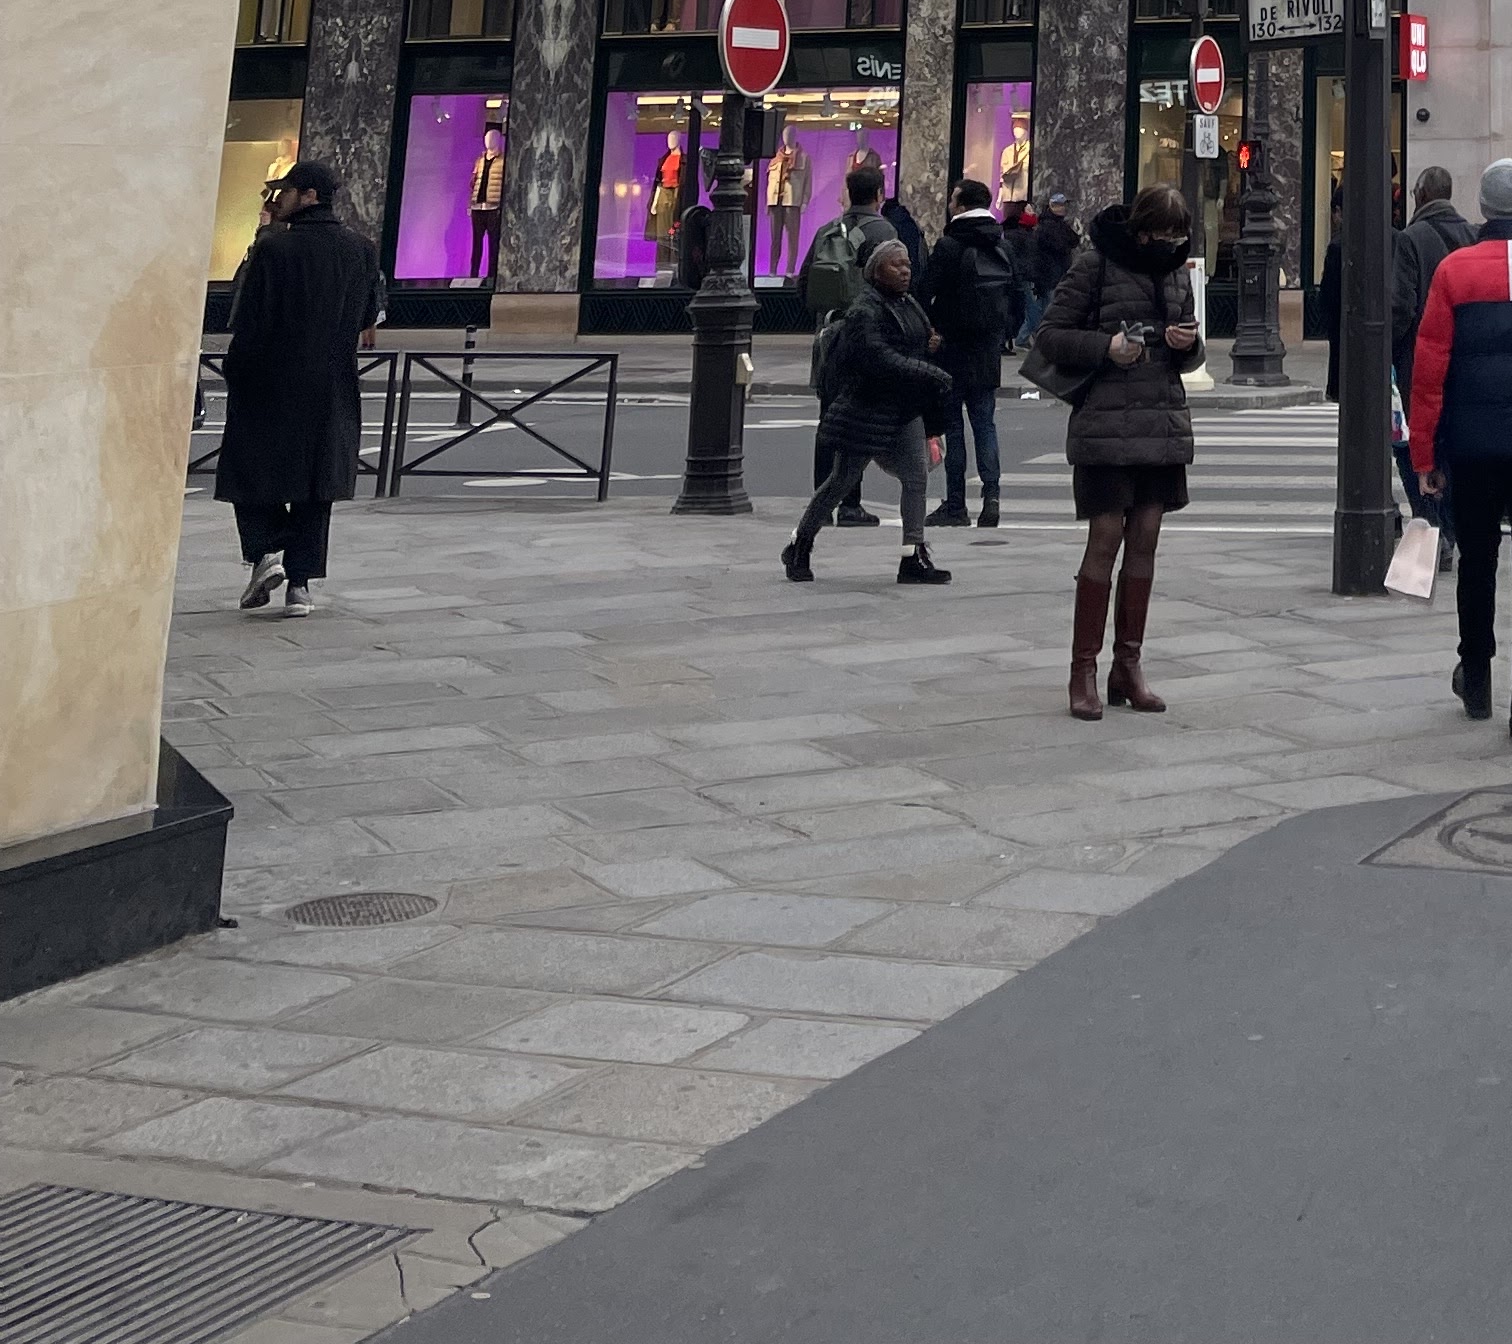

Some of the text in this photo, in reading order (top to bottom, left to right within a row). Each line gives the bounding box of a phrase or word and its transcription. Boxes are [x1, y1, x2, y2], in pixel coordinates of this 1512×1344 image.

[1252, 14, 1343, 39] 130 132
[1260, 6, 1277, 22] DE
[1410, 22, 1426, 47] UNI
[1410, 49, 1428, 77] QLO
[1199, 118, 1215, 129] SAUF
